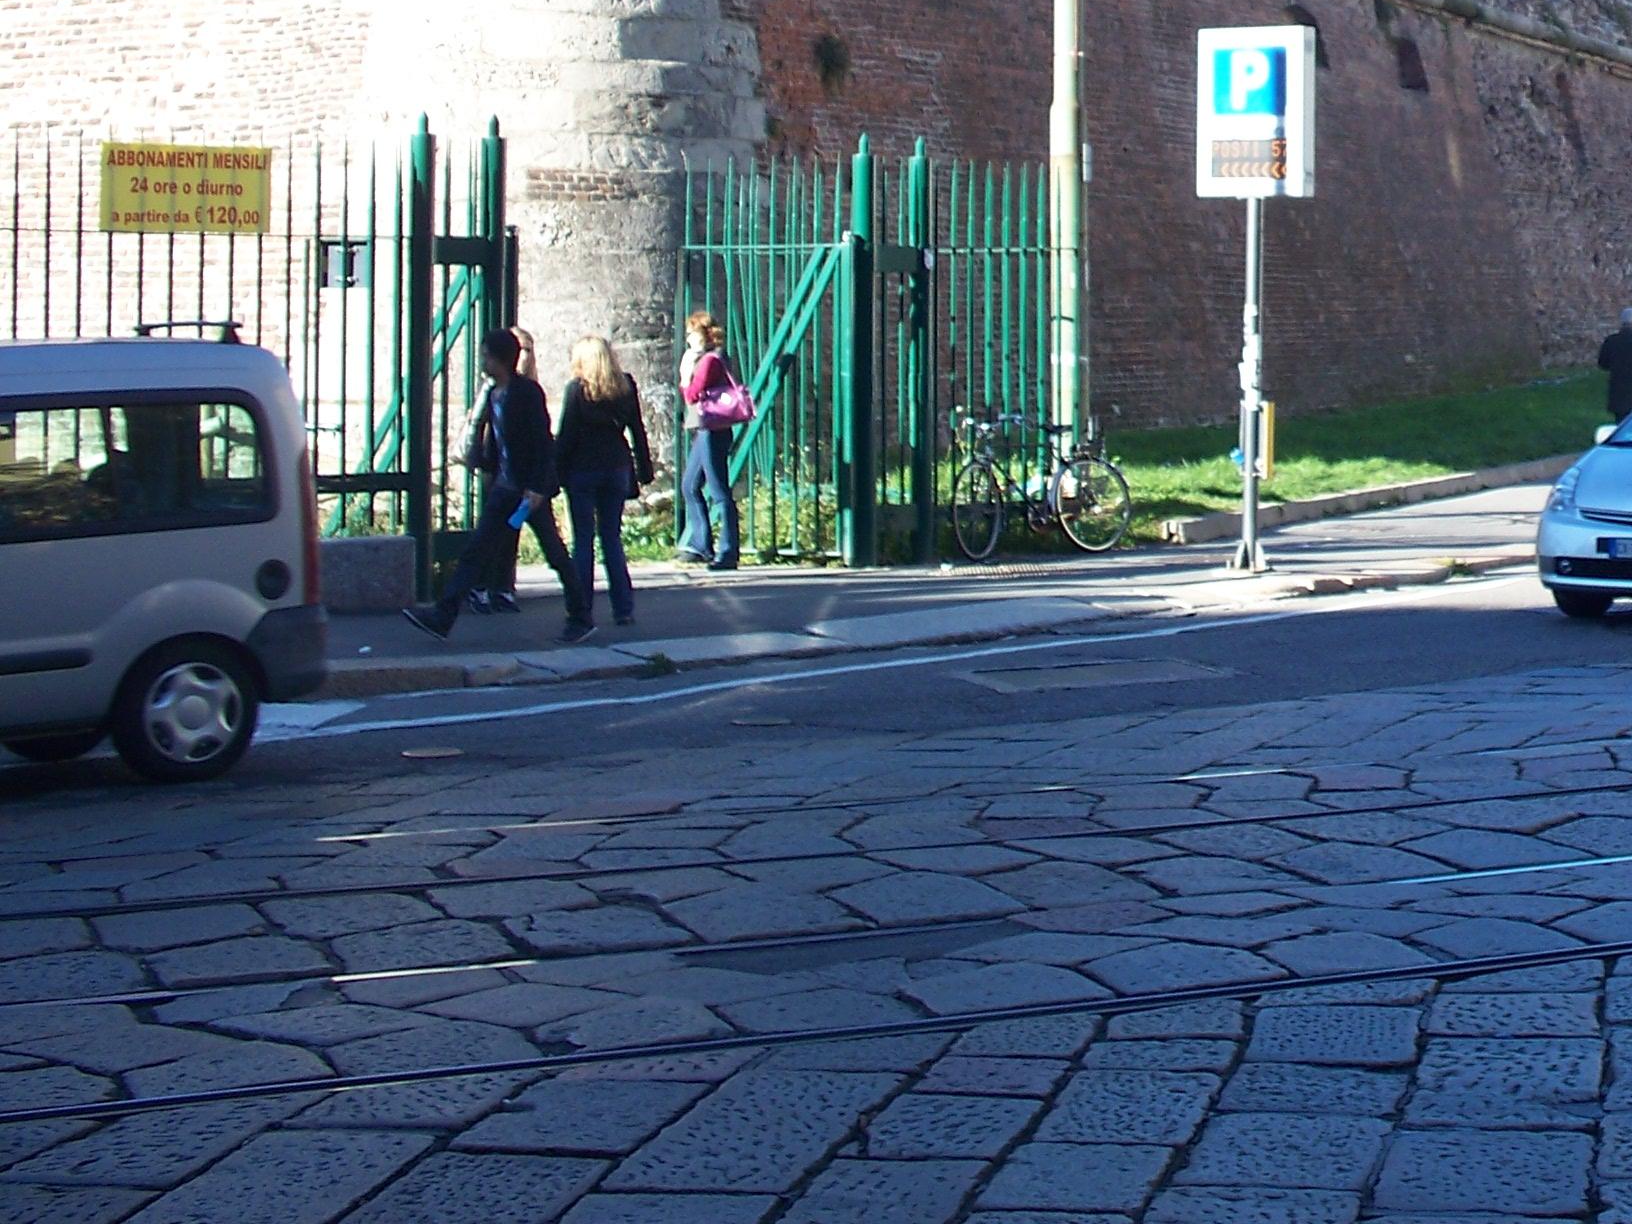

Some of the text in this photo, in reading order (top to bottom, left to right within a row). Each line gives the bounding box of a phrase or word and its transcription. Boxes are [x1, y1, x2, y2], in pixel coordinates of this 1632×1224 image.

[1230, 50, 1269, 110] P
[107, 149, 267, 170] ABBONAMENTI MENSILI
[130, 177, 243, 196] 24 ore o diurno
[112, 210, 120, 222] a
[124, 209, 170, 226] partire
[173, 209, 190, 223] da
